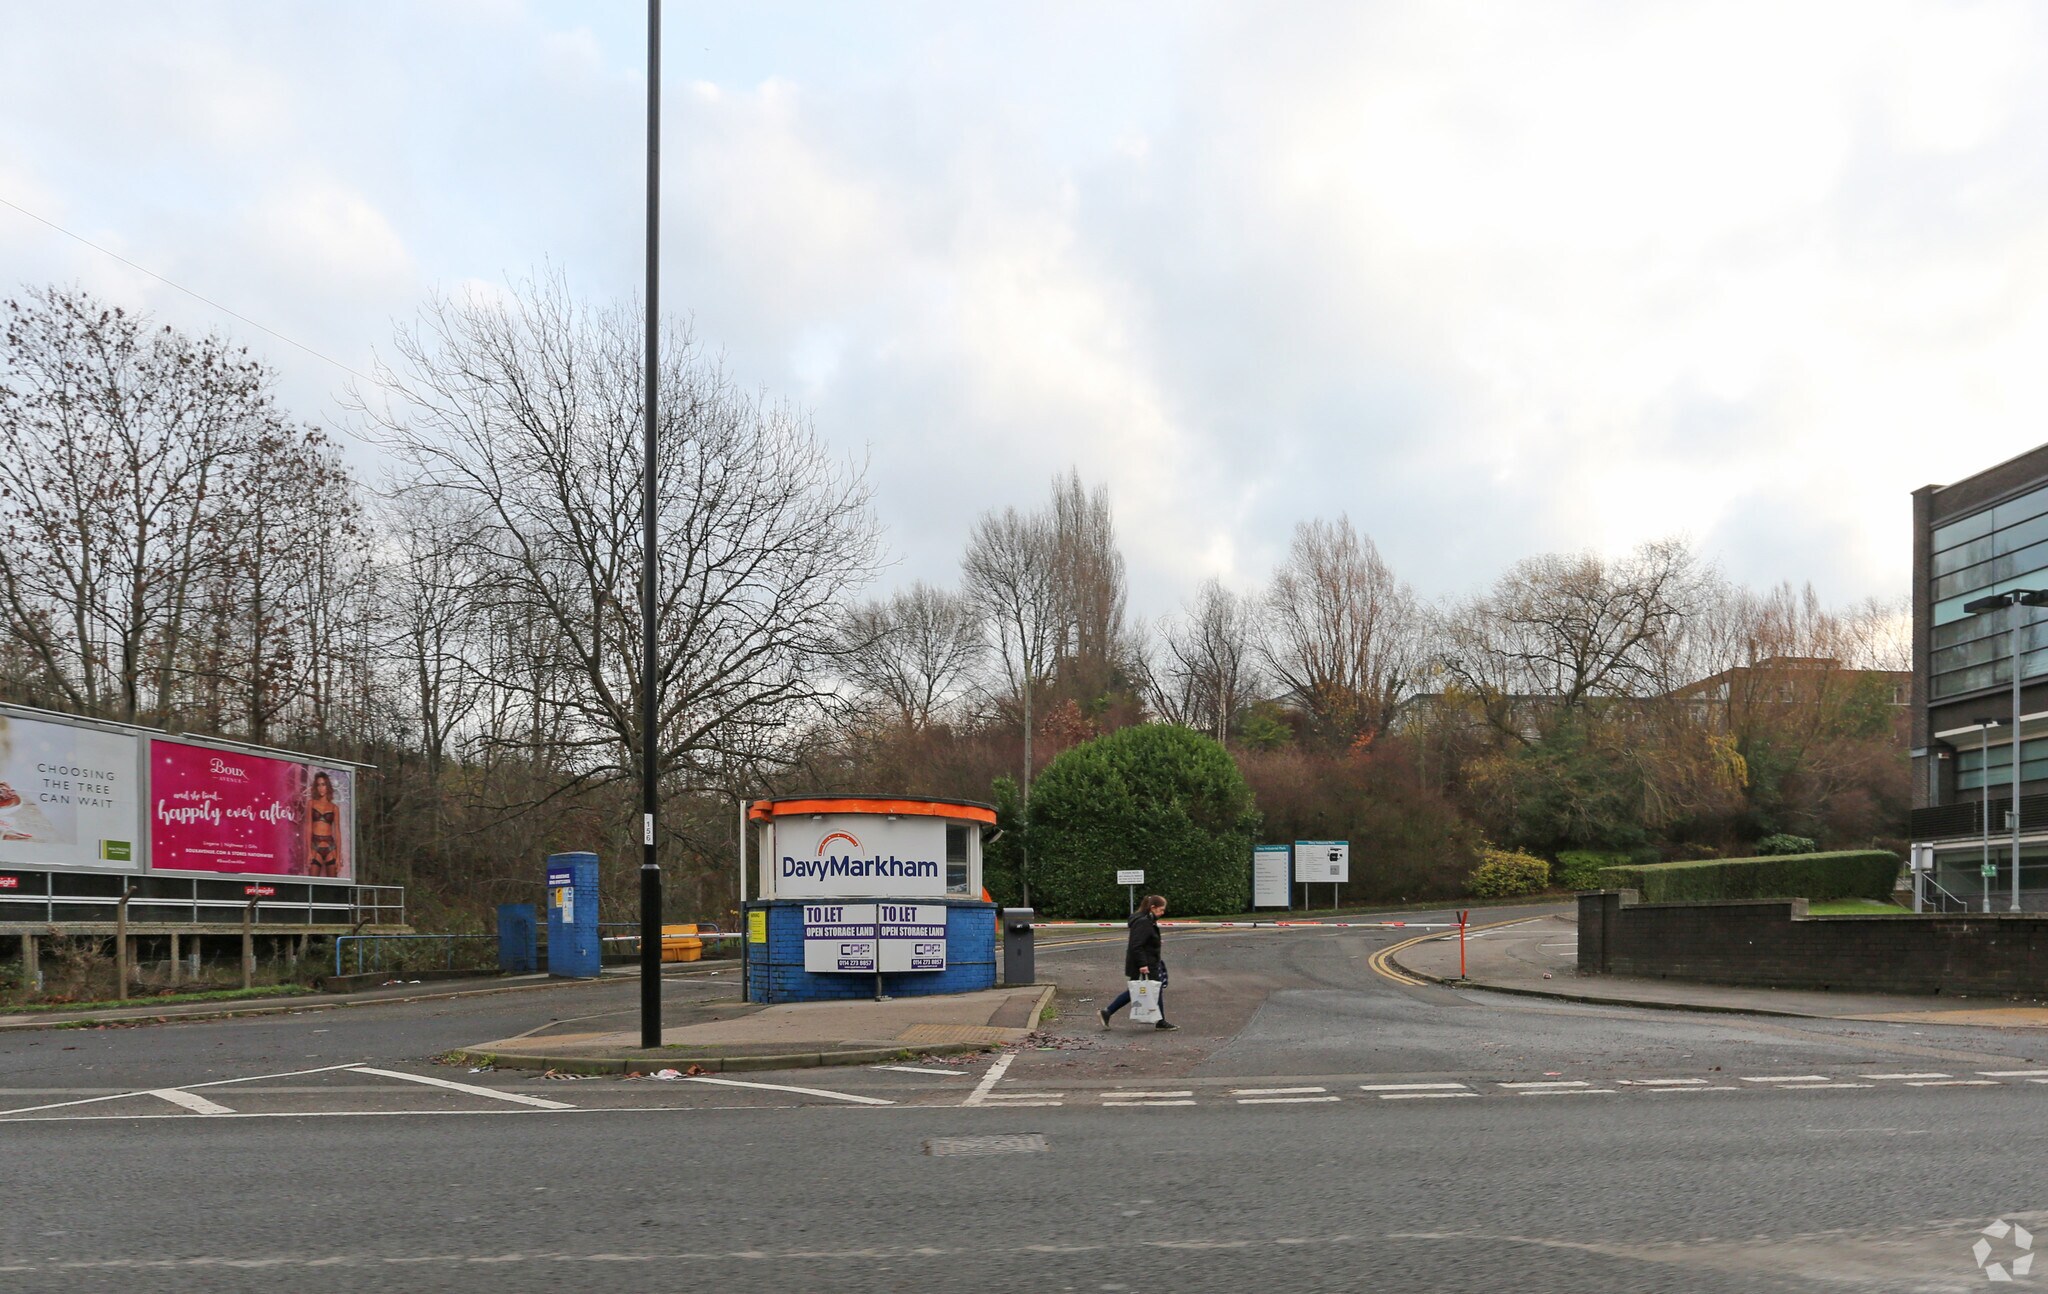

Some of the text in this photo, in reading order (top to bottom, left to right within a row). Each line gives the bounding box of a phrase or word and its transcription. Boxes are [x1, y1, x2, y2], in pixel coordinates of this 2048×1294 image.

[37, 763, 115, 781] CHOOSING
[210, 757, 249, 780] Boux
[43, 778, 110, 795] THE TREE
[39, 793, 113, 808] CAN WAIT
[173, 790, 189, 800] and
[158, 799, 295, 826] happily ever after
[783, 855, 938, 882] DavyMarkham
[246, 886, 274, 896] priesight
[806, 906, 843, 923] TO LET
[881, 906, 917, 922] TO LET
[806, 926, 874, 937] OPEN STORAGE LAND
[881, 926, 944, 936] OPEN STORAGE LAND
[840, 943, 870, 955] CPP
[914, 943, 941, 955] CPP
